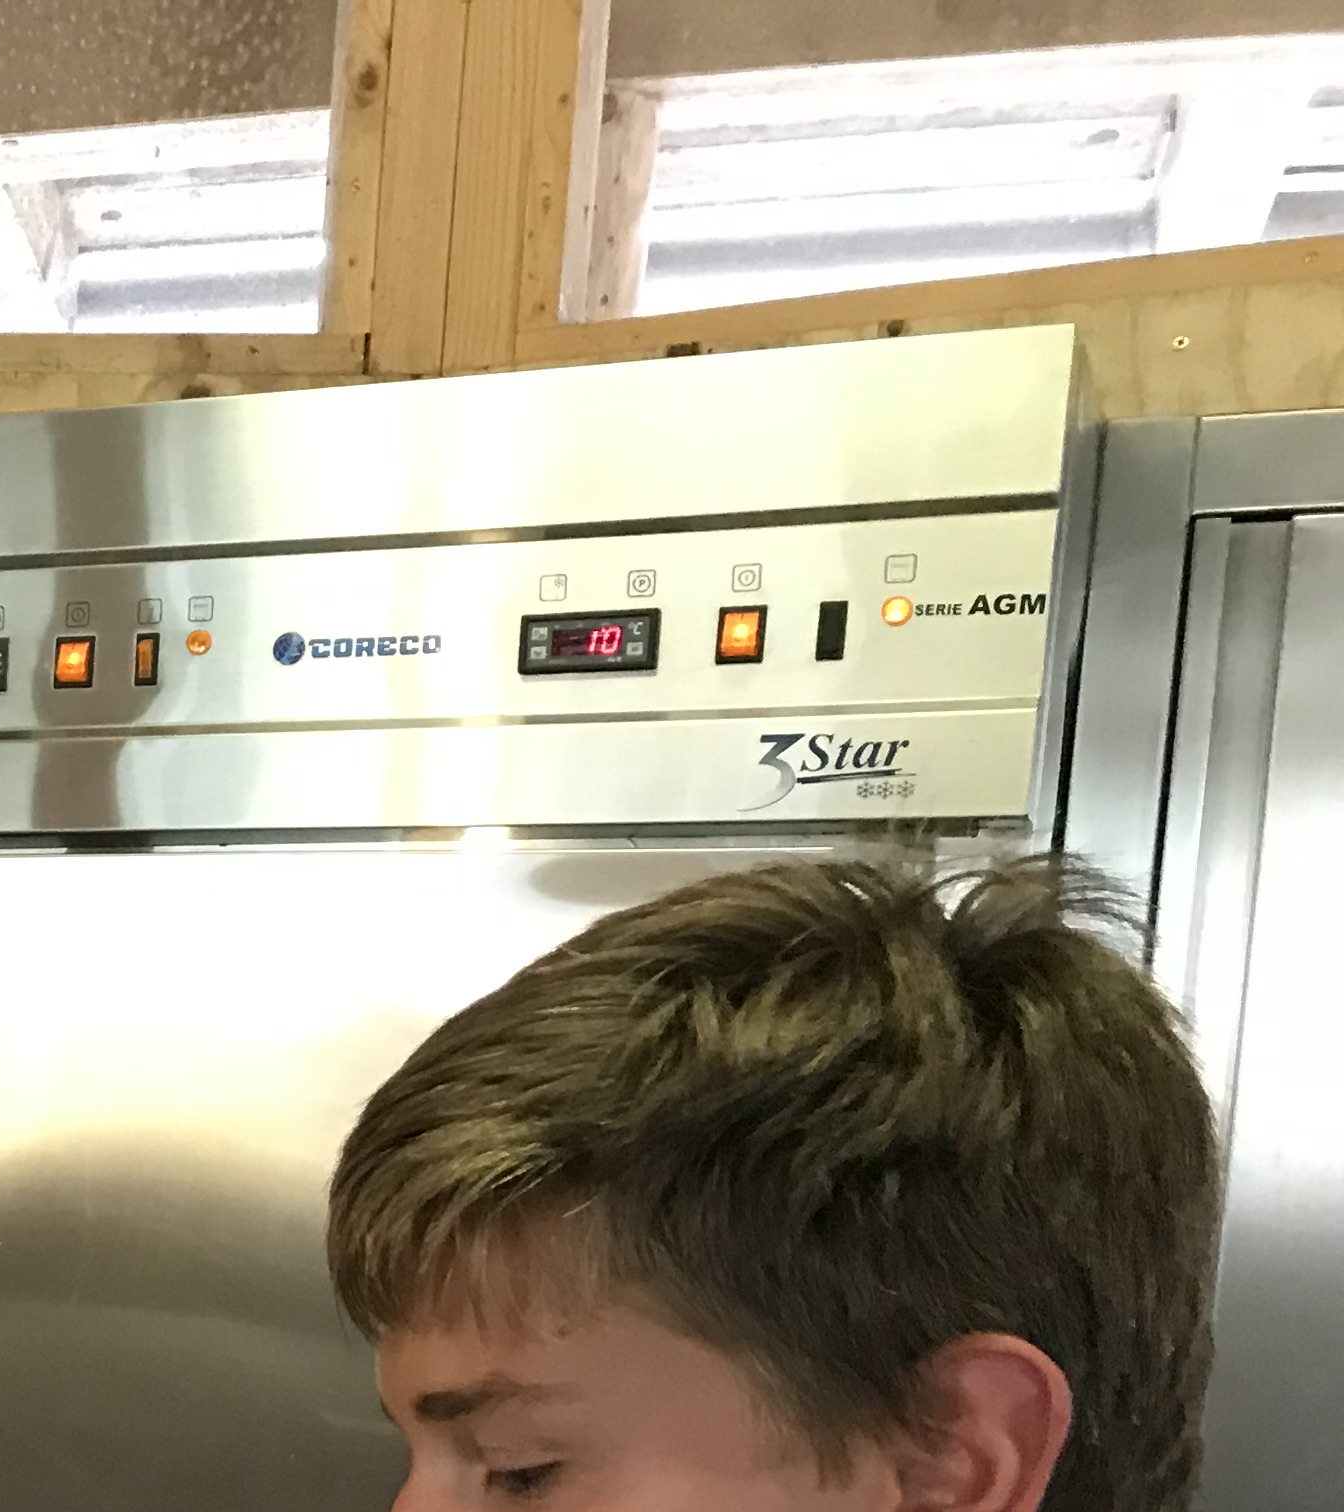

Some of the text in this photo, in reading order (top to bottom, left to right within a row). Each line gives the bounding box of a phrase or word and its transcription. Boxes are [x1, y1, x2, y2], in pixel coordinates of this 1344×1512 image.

[914, 593, 1047, 617] SERIE AGM
[308, 634, 442, 659] CORECO
